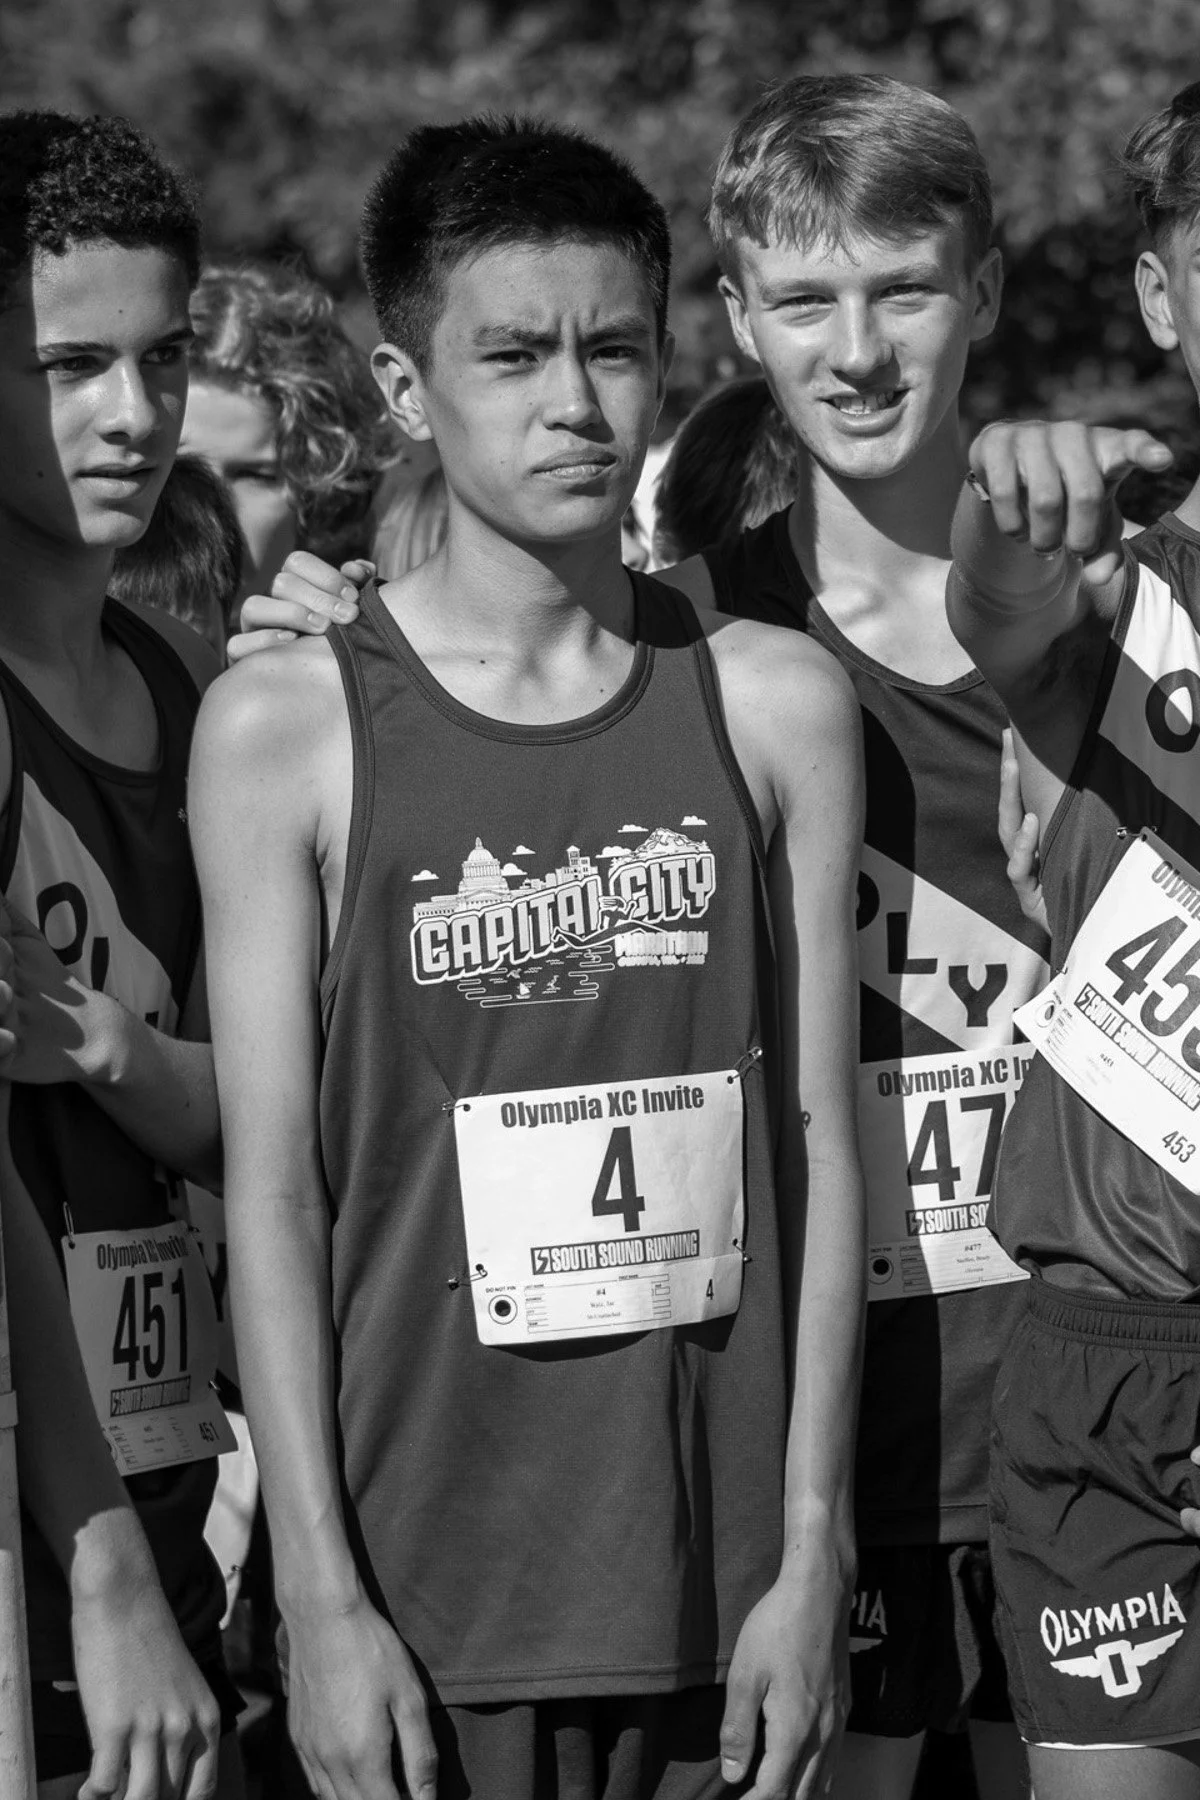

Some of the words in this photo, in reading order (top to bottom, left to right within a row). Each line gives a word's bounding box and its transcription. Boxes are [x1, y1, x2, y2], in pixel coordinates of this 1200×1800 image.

[610, 853, 716, 923] CITY
[878, 1064, 973, 1098] Olympia
[979, 1058, 1009, 1085] XC
[501, 1095, 603, 1128] Olympia
[607, 1090, 638, 1117] XC
[643, 1086, 705, 1114] Invite
[907, 1092, 1022, 1202] 47
[1161, 1130, 1198, 1164] 453
[591, 1126, 646, 1233] 4
[924, 1206, 969, 1233] SOUTH
[970, 1203, 990, 1228] SO
[97, 1240, 149, 1271] Olympia
[550, 1244, 597, 1273] SOUTH
[599, 1238, 643, 1267] SOUND
[645, 1232, 699, 1262] RUNNING
[706, 1279, 714, 1300] 4
[112, 1267, 188, 1382] 451
[1041, 1582, 1187, 1656] OLYMPIA
